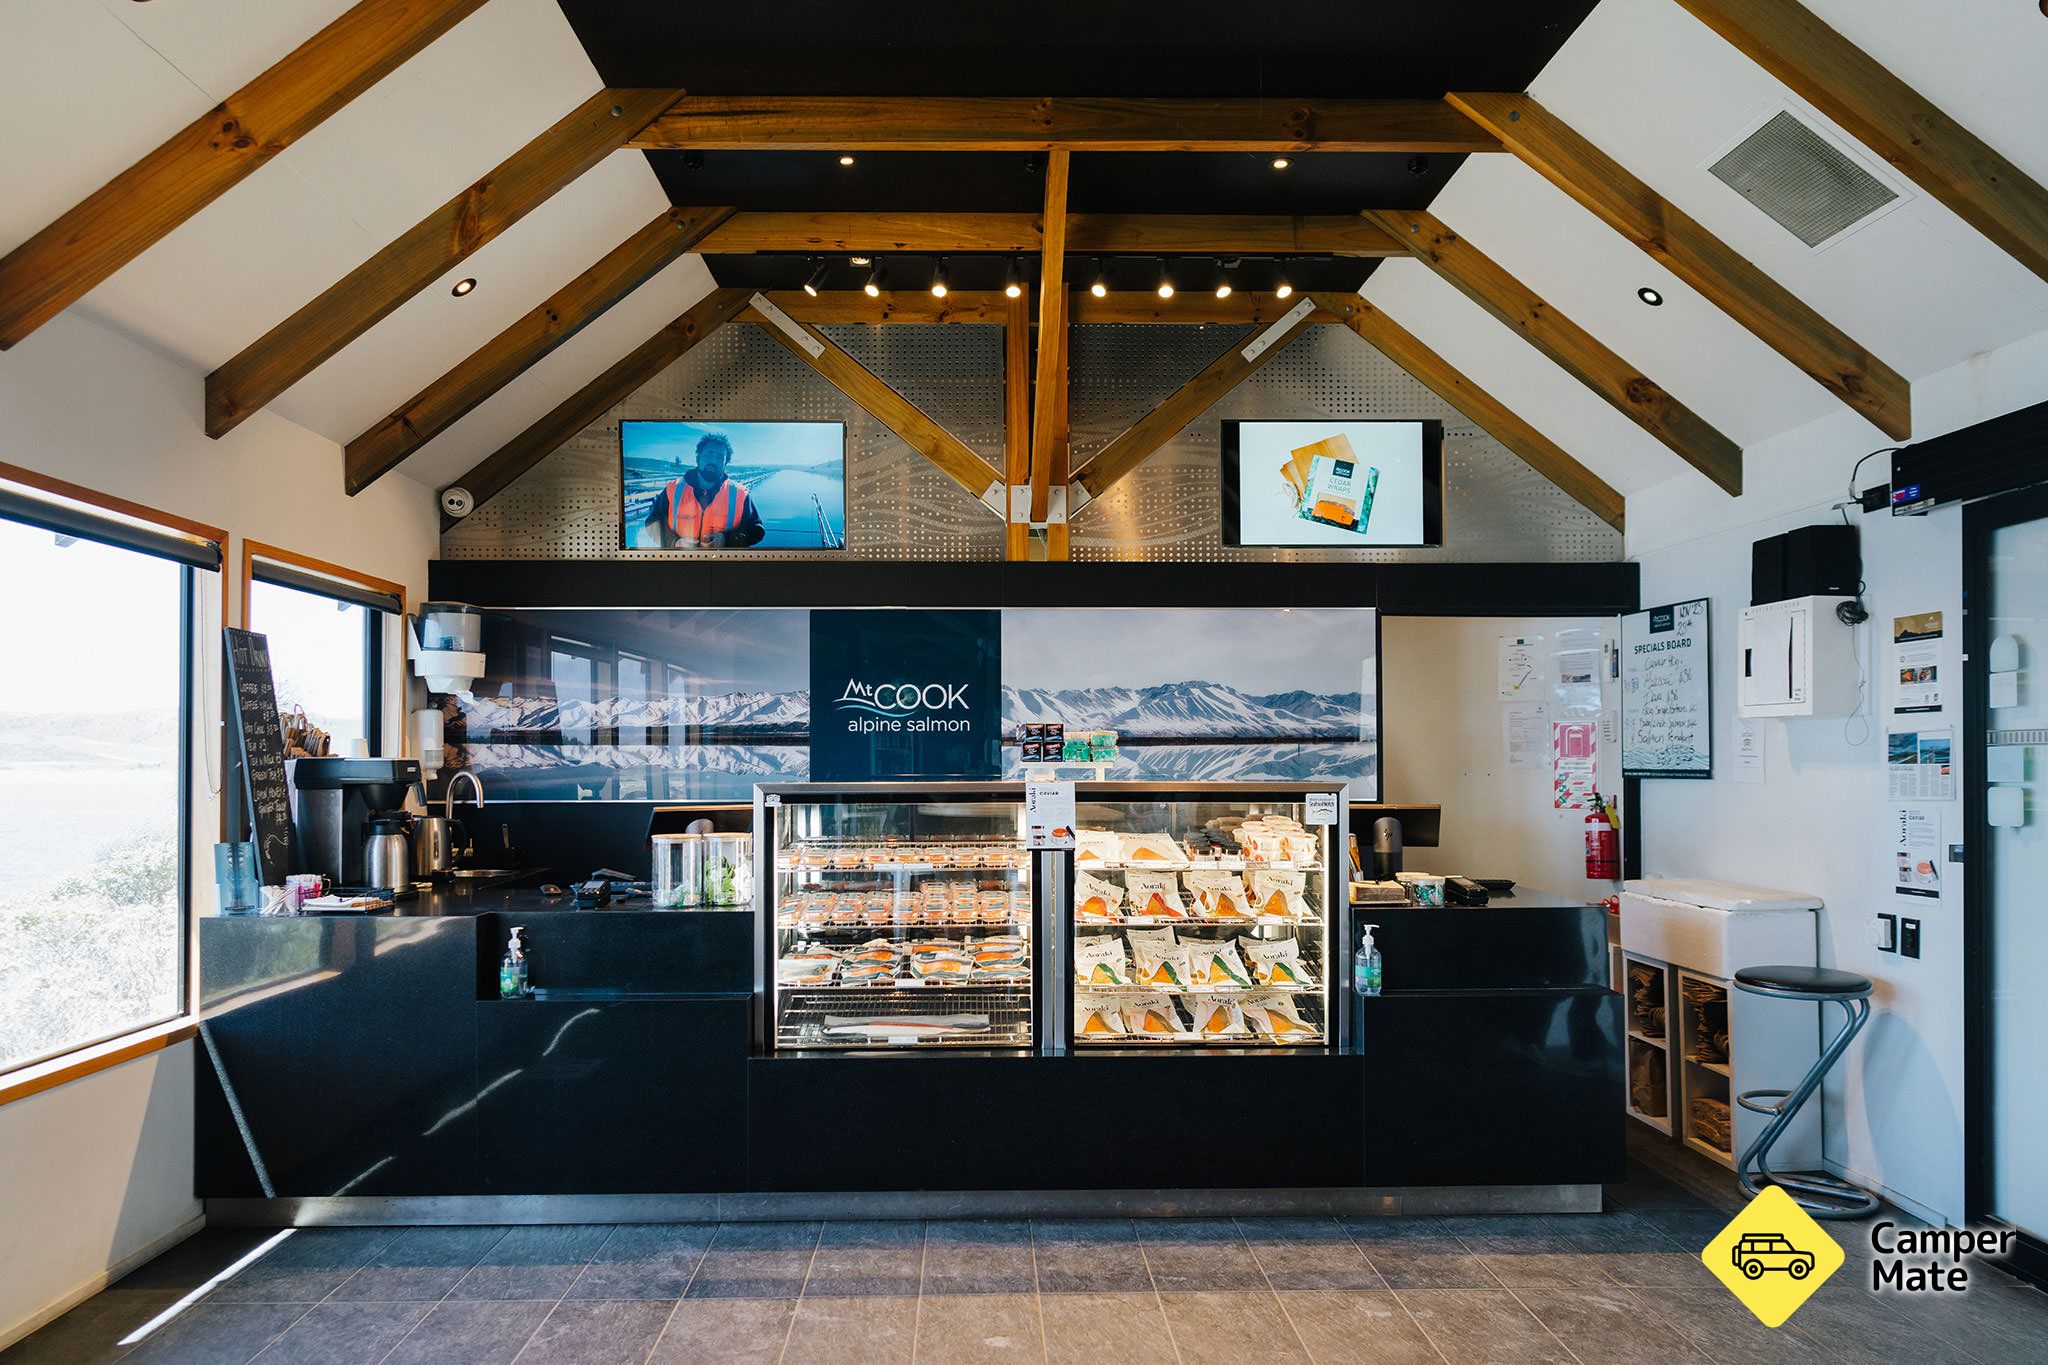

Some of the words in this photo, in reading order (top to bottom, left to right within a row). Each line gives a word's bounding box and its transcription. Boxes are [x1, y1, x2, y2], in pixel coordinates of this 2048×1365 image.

[1634, 641, 1665, 655] SPECIALS
[1667, 638, 1692, 650] BOARD
[874, 684, 970, 710] COOK
[848, 716, 901, 735] alpine
[907, 716, 970, 732] salmon
[1267, 876, 1293, 887] Aoraki
[1263, 951, 1288, 960] Aoraki
[1134, 999, 1160, 1008] Aoraki
